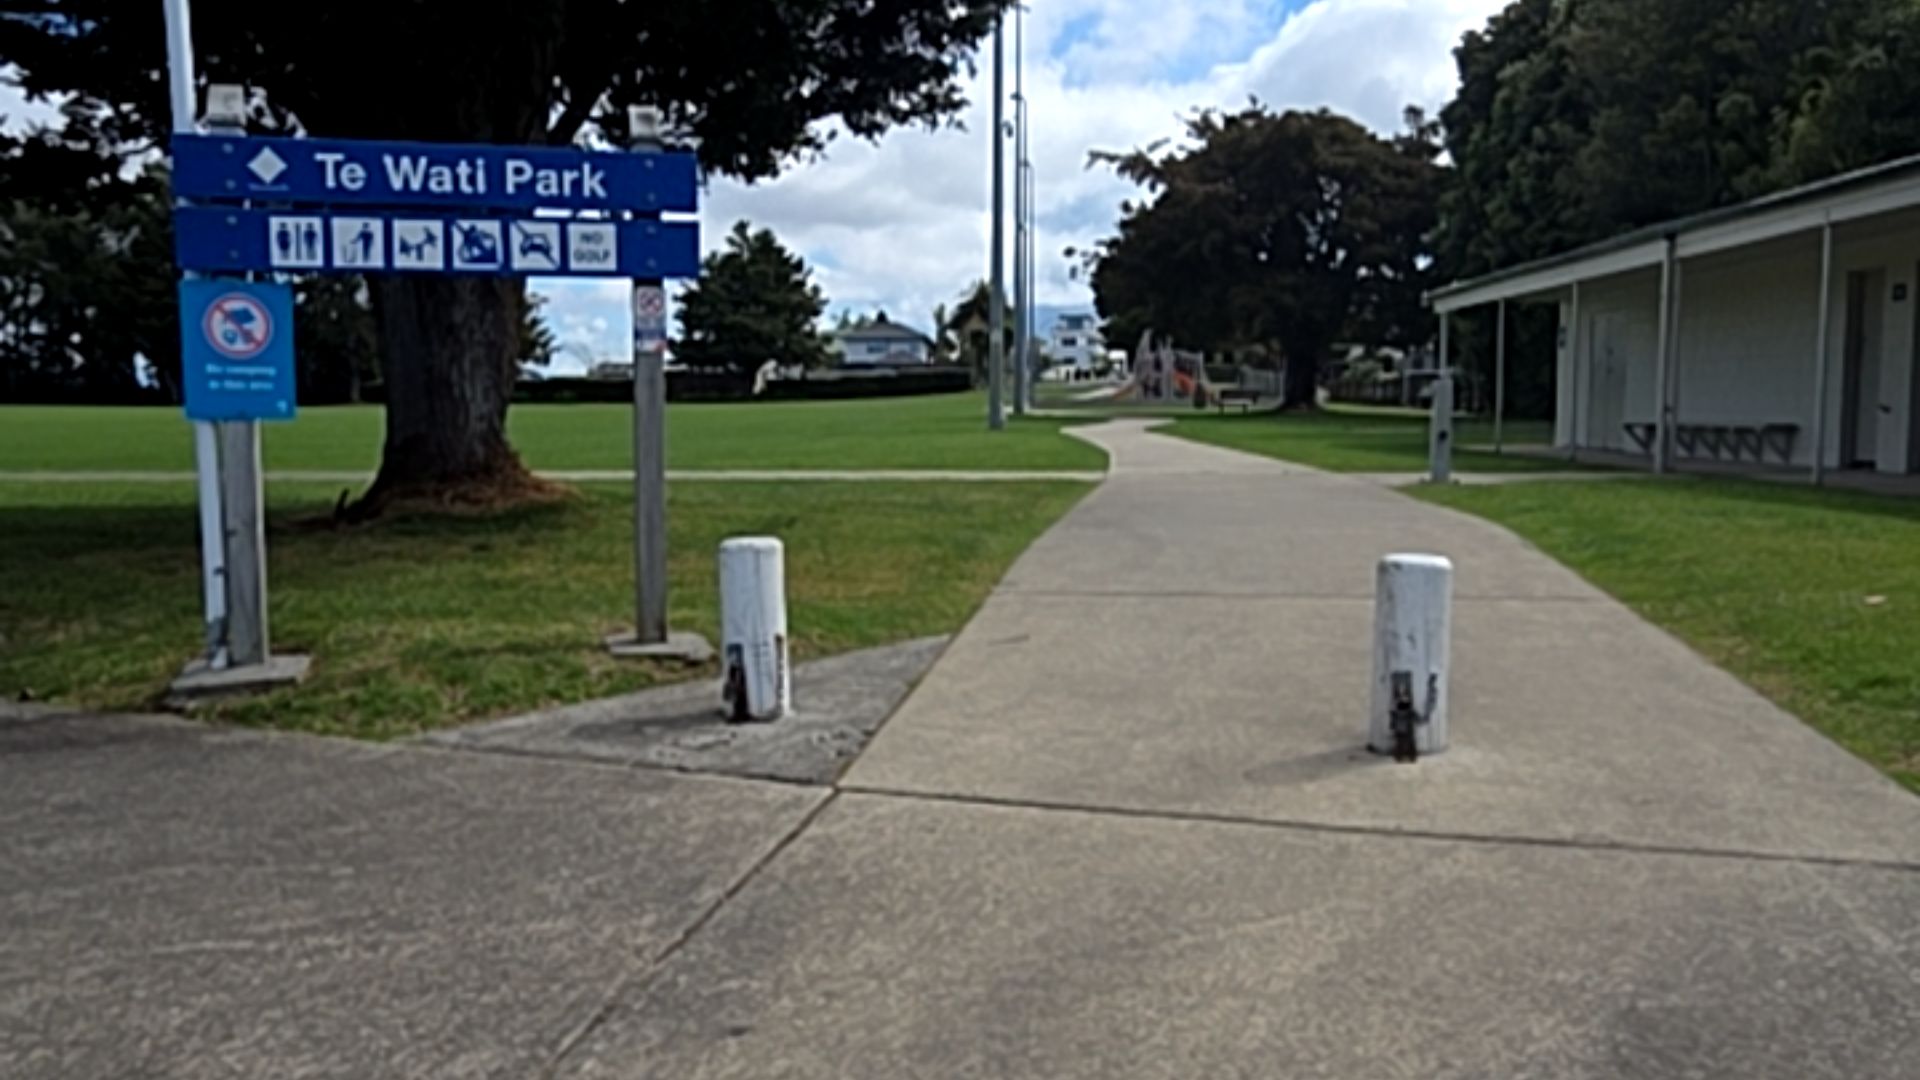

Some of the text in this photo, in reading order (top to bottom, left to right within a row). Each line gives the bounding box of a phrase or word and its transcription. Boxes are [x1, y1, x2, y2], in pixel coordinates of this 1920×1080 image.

[314, 152, 607, 198] Te Wati Park
[580, 231, 604, 245] NO
[573, 249, 611, 263] GOLF
